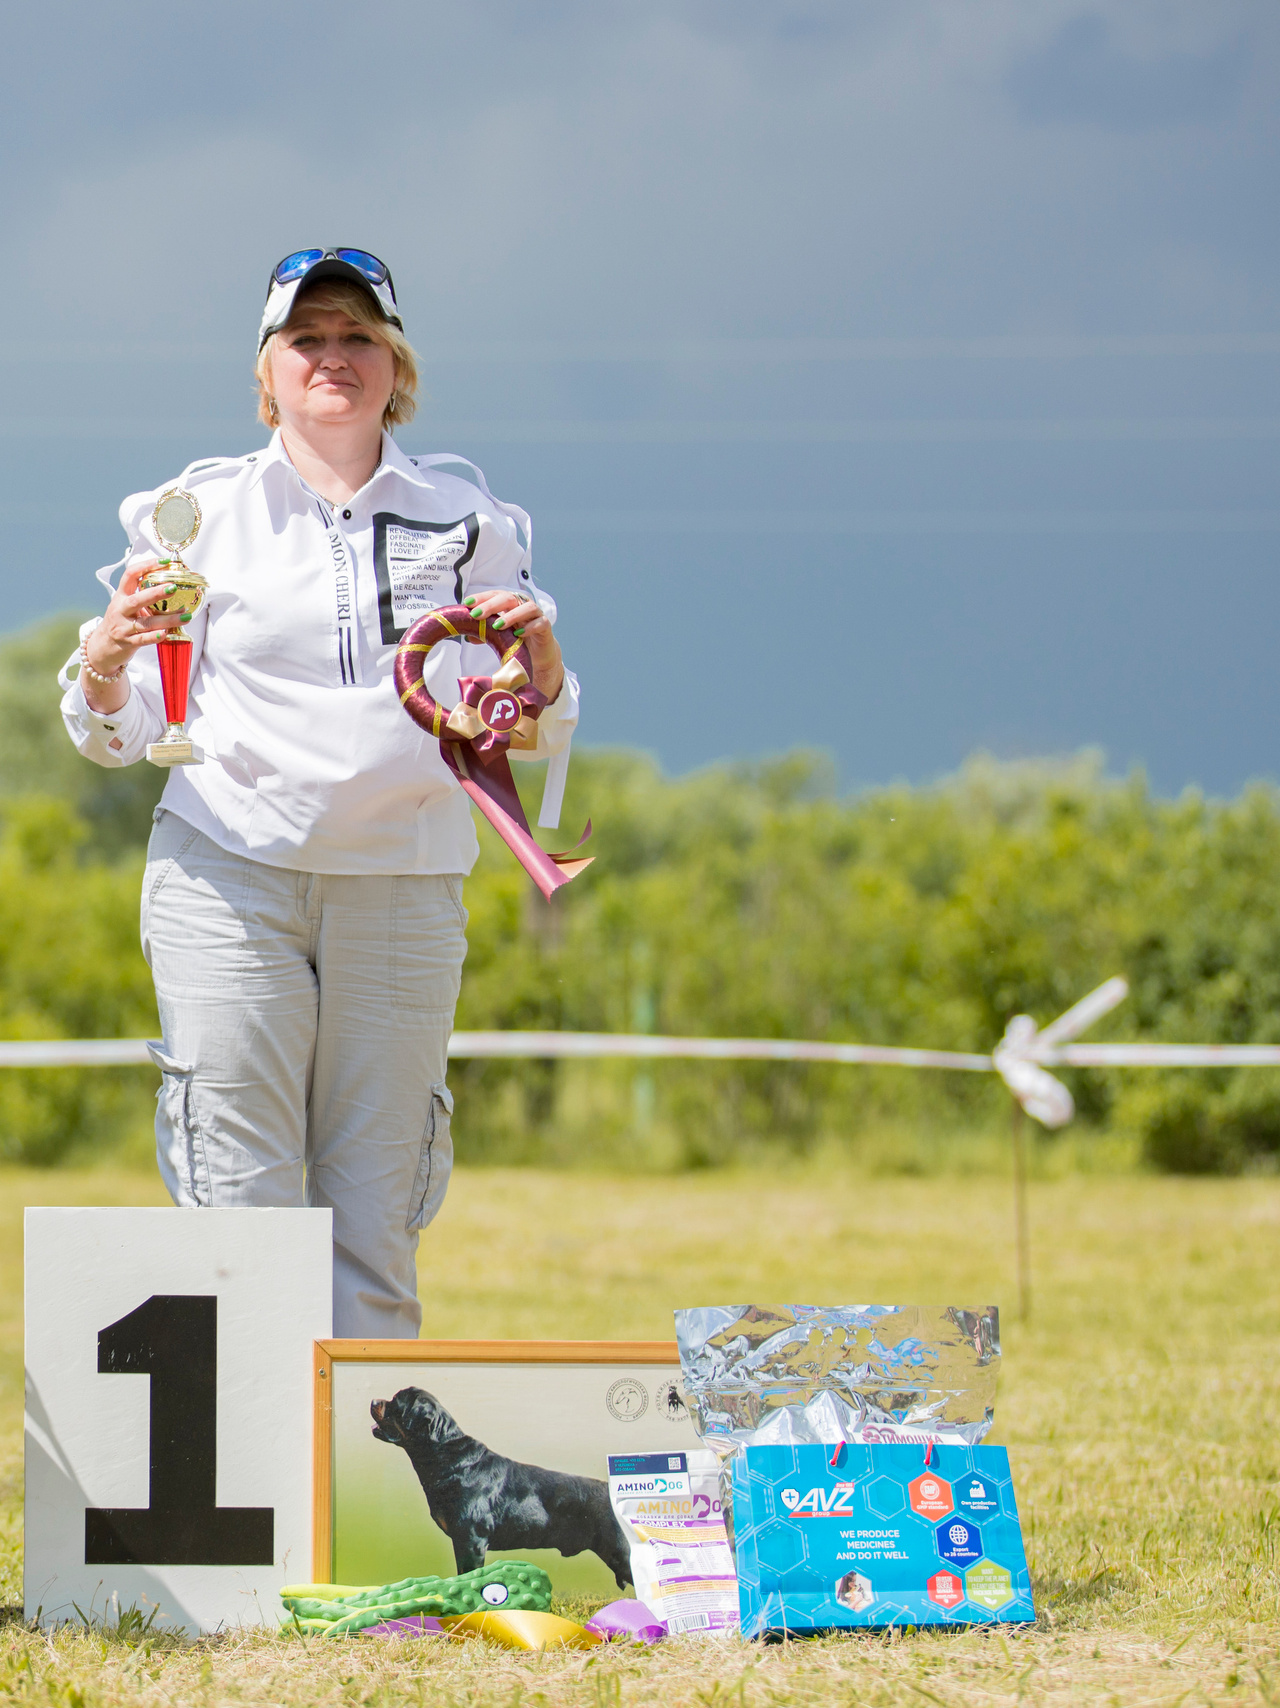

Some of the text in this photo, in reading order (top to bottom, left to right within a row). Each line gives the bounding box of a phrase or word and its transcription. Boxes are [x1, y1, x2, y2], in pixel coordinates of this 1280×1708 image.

[389, 527, 432, 539] REVOLUTION
[390, 541, 426, 550] FASCINATE
[329, 533, 351, 621] MON CHERI
[84, 1294, 276, 1567] 1
[792, 1487, 855, 1512] AVZ
[636, 1494, 721, 1519] AMINODO
[840, 1529, 901, 1539] WE PRODUCE
[847, 1540, 896, 1550] MEDICINES
[836, 1550, 910, 1561] AND DO IT WELL
